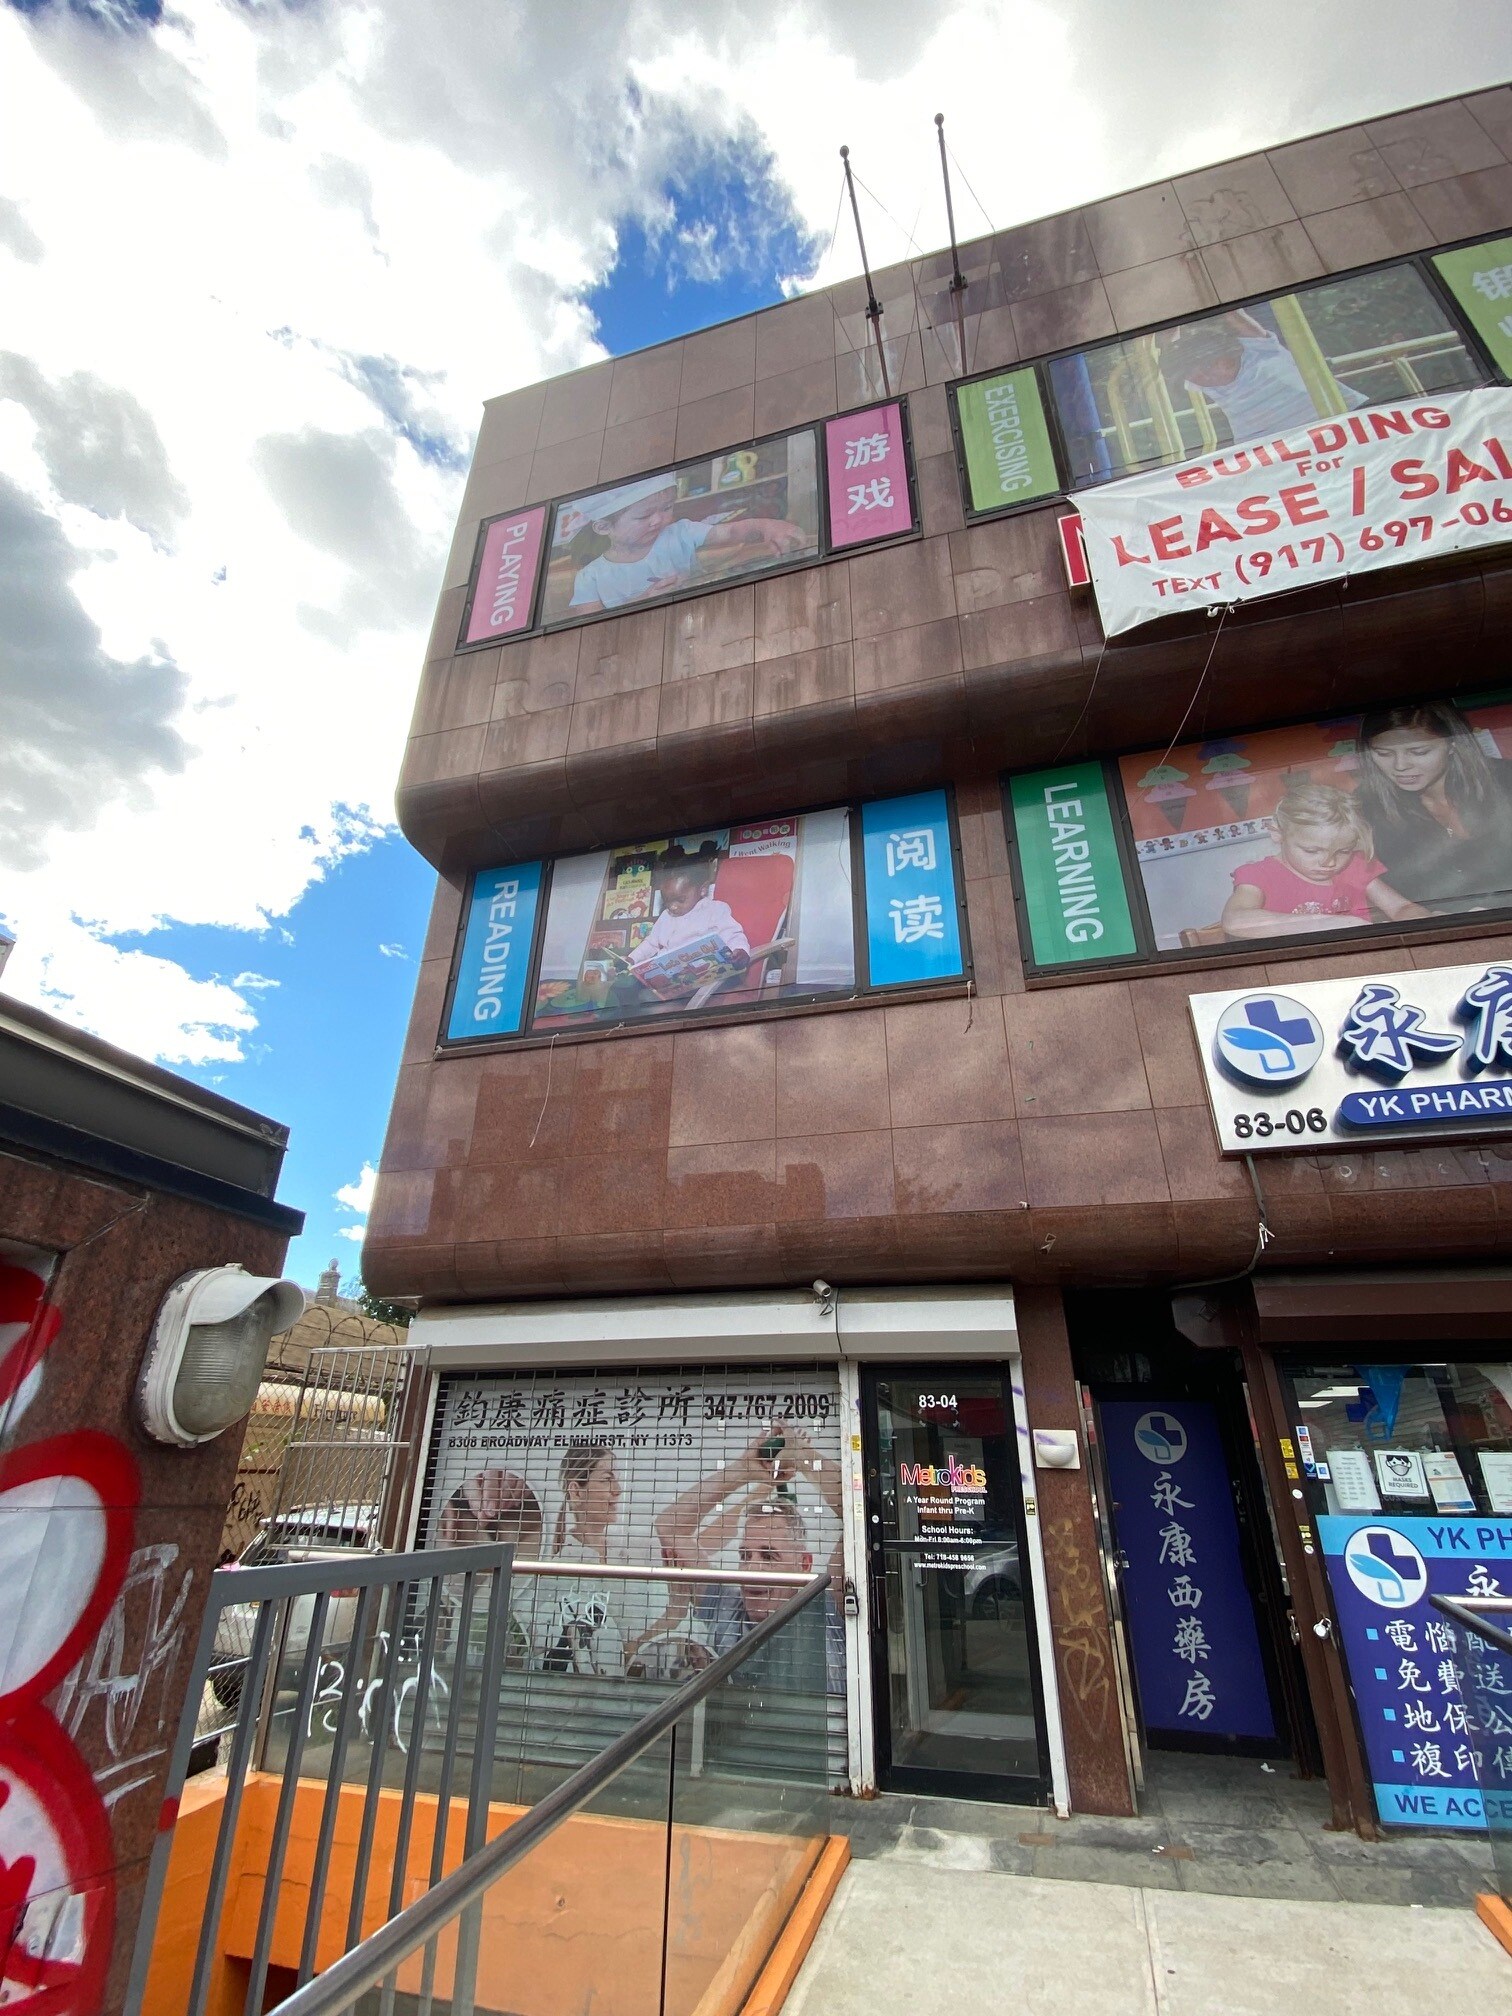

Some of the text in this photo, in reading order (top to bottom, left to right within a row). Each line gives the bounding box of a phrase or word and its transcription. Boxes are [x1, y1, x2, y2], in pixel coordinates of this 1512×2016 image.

[984, 383, 1032, 493] EXERCISING
[1175, 406, 1452, 489] BUILDING
[845, 432, 894, 515] 游戏
[1298, 456, 1345, 478] For
[1109, 482, 1330, 568] LEASE
[489, 521, 528, 627] PLAYING
[1152, 571, 1222, 598] TEXT
[1234, 532, 1346, 585] (917)
[758, 840, 791, 852] Walking
[1043, 782, 1105, 944] LEARNING
[886, 828, 945, 944] 阅读
[473, 879, 520, 1022] READING
[1358, 1095, 1405, 1118] YK
[1233, 1108, 1328, 1138] 83-06
[704, 1393, 830, 1421] 347.767.2009
[918, 1394, 958, 1408] 83-04
[449, 1433, 693, 1448] 8308 BROADWAY ELMHURST, NY 11373
[900, 1454, 987, 1487] Metrokids
[913, 1496, 928, 1504] Year
[930, 1496, 953, 1504] Round
[954, 1497, 985, 1506] Program
[917, 1506, 975, 1515] Infant thru Pre-K
[921, 1525, 974, 1534] School Hours:
[1427, 1526, 1471, 1549] YK
[1150, 1471, 1216, 1721] 永康西藥房
[1394, 1793, 1438, 1815] WE
